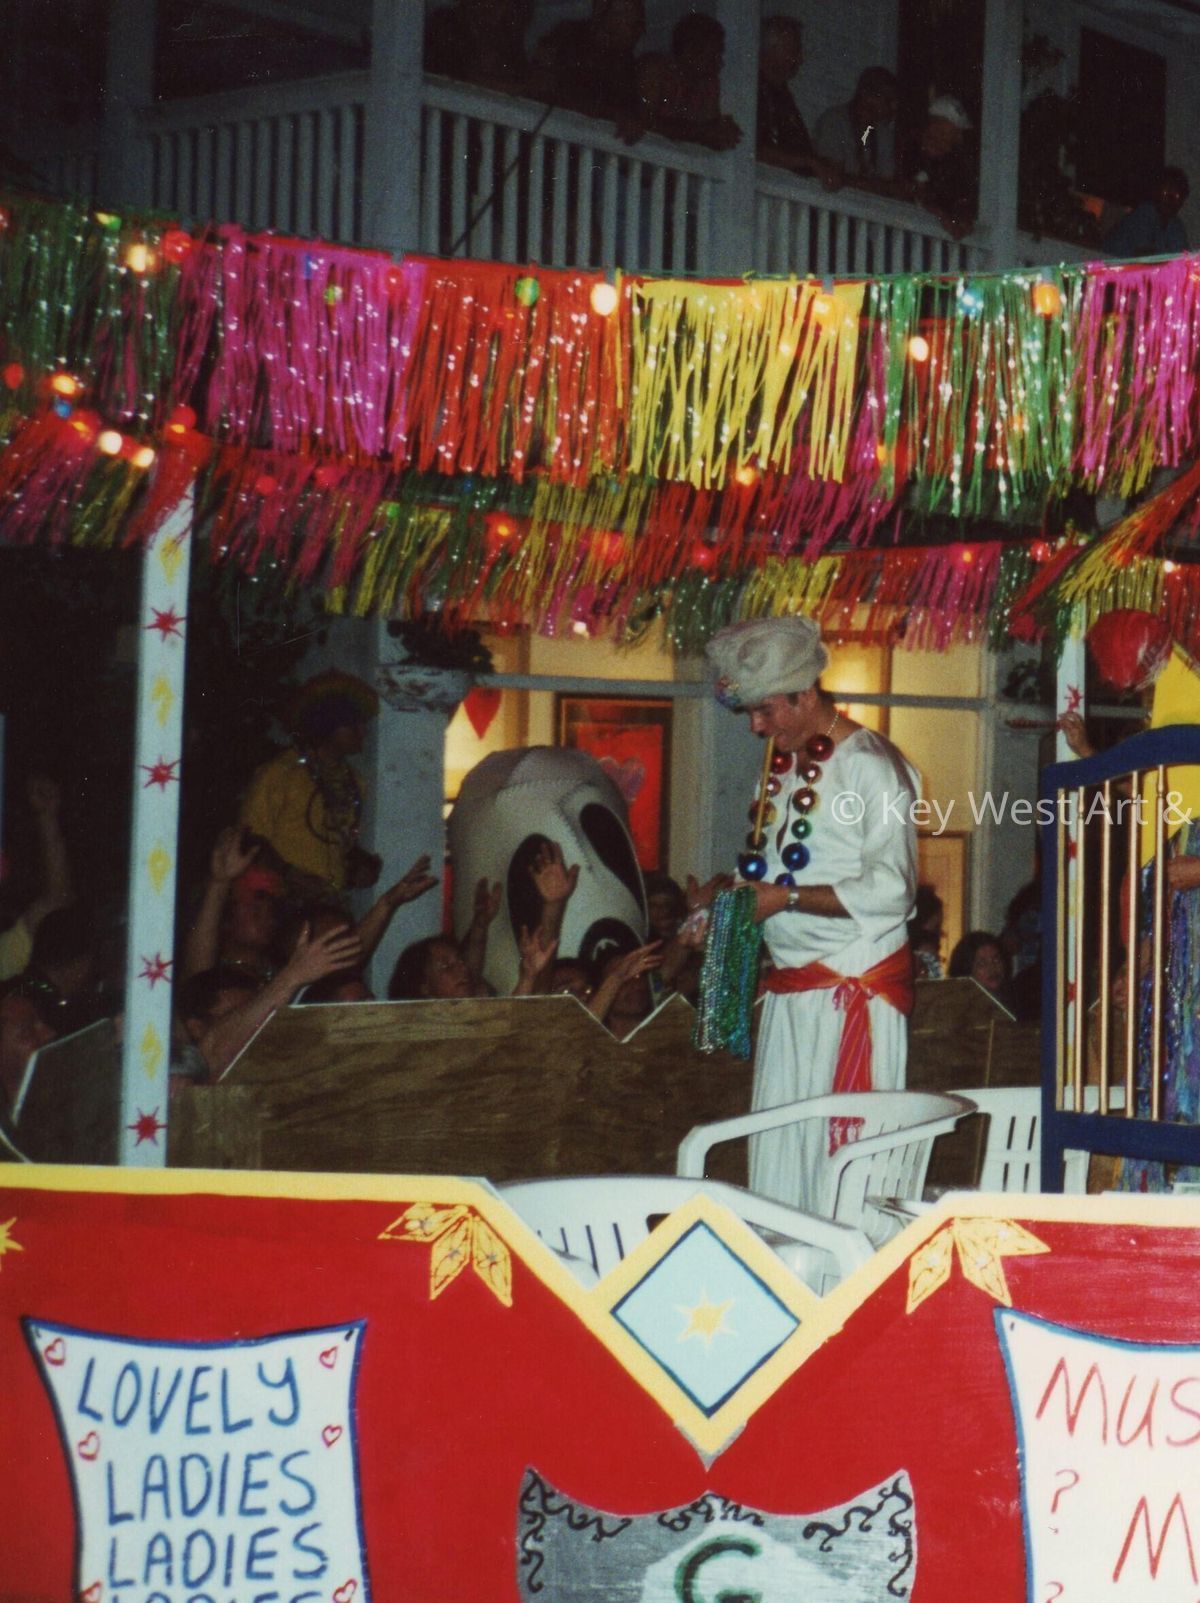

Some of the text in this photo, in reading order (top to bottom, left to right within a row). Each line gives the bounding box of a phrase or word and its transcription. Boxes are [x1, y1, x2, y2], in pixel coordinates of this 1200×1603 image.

[77, 1356, 301, 1435] LOVELY
[106, 1448, 318, 1526] LADIES
[108, 1522, 329, 1589] LADIES
